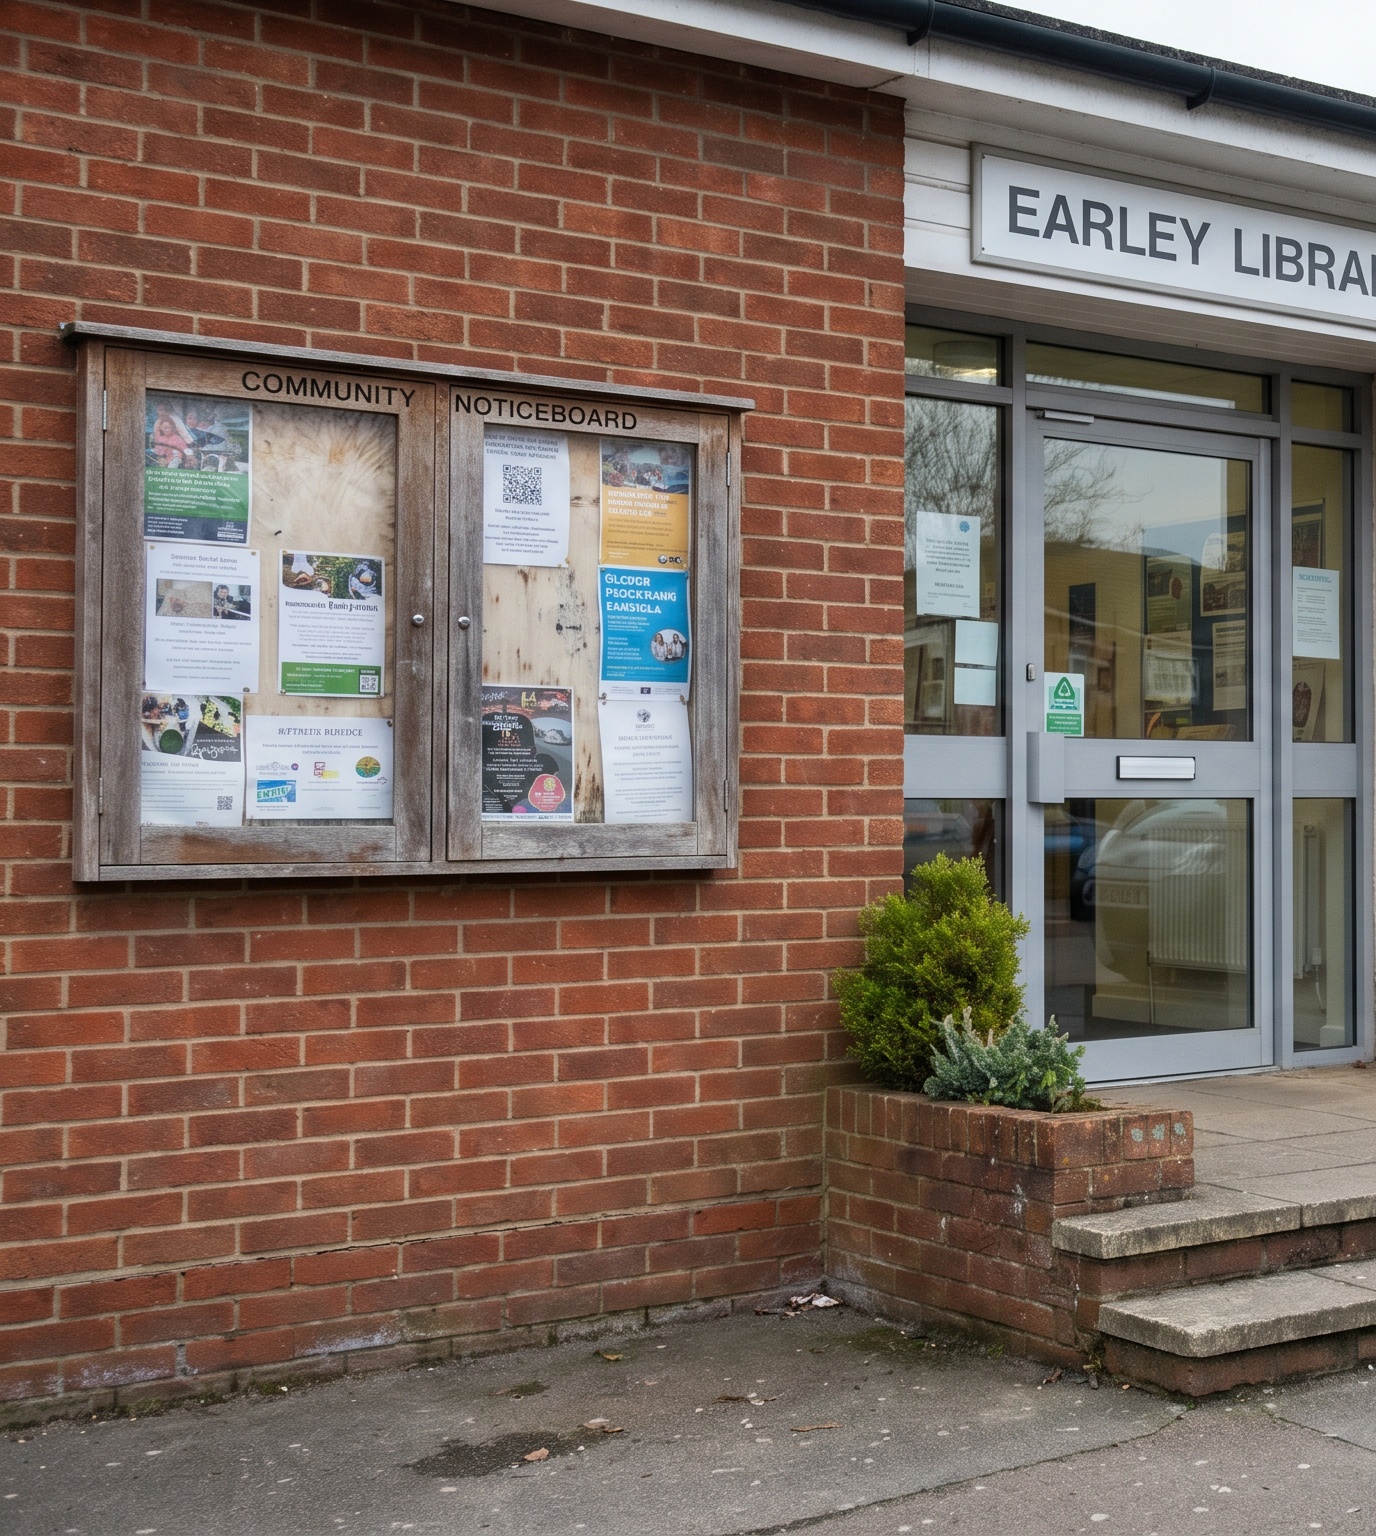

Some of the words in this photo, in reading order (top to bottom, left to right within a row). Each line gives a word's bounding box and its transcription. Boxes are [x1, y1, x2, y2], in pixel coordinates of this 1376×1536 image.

[1008, 185, 1211, 265] EARLEY
[241, 370, 415, 408] COMMUNITY
[455, 394, 638, 431] NOTICEBOARD
